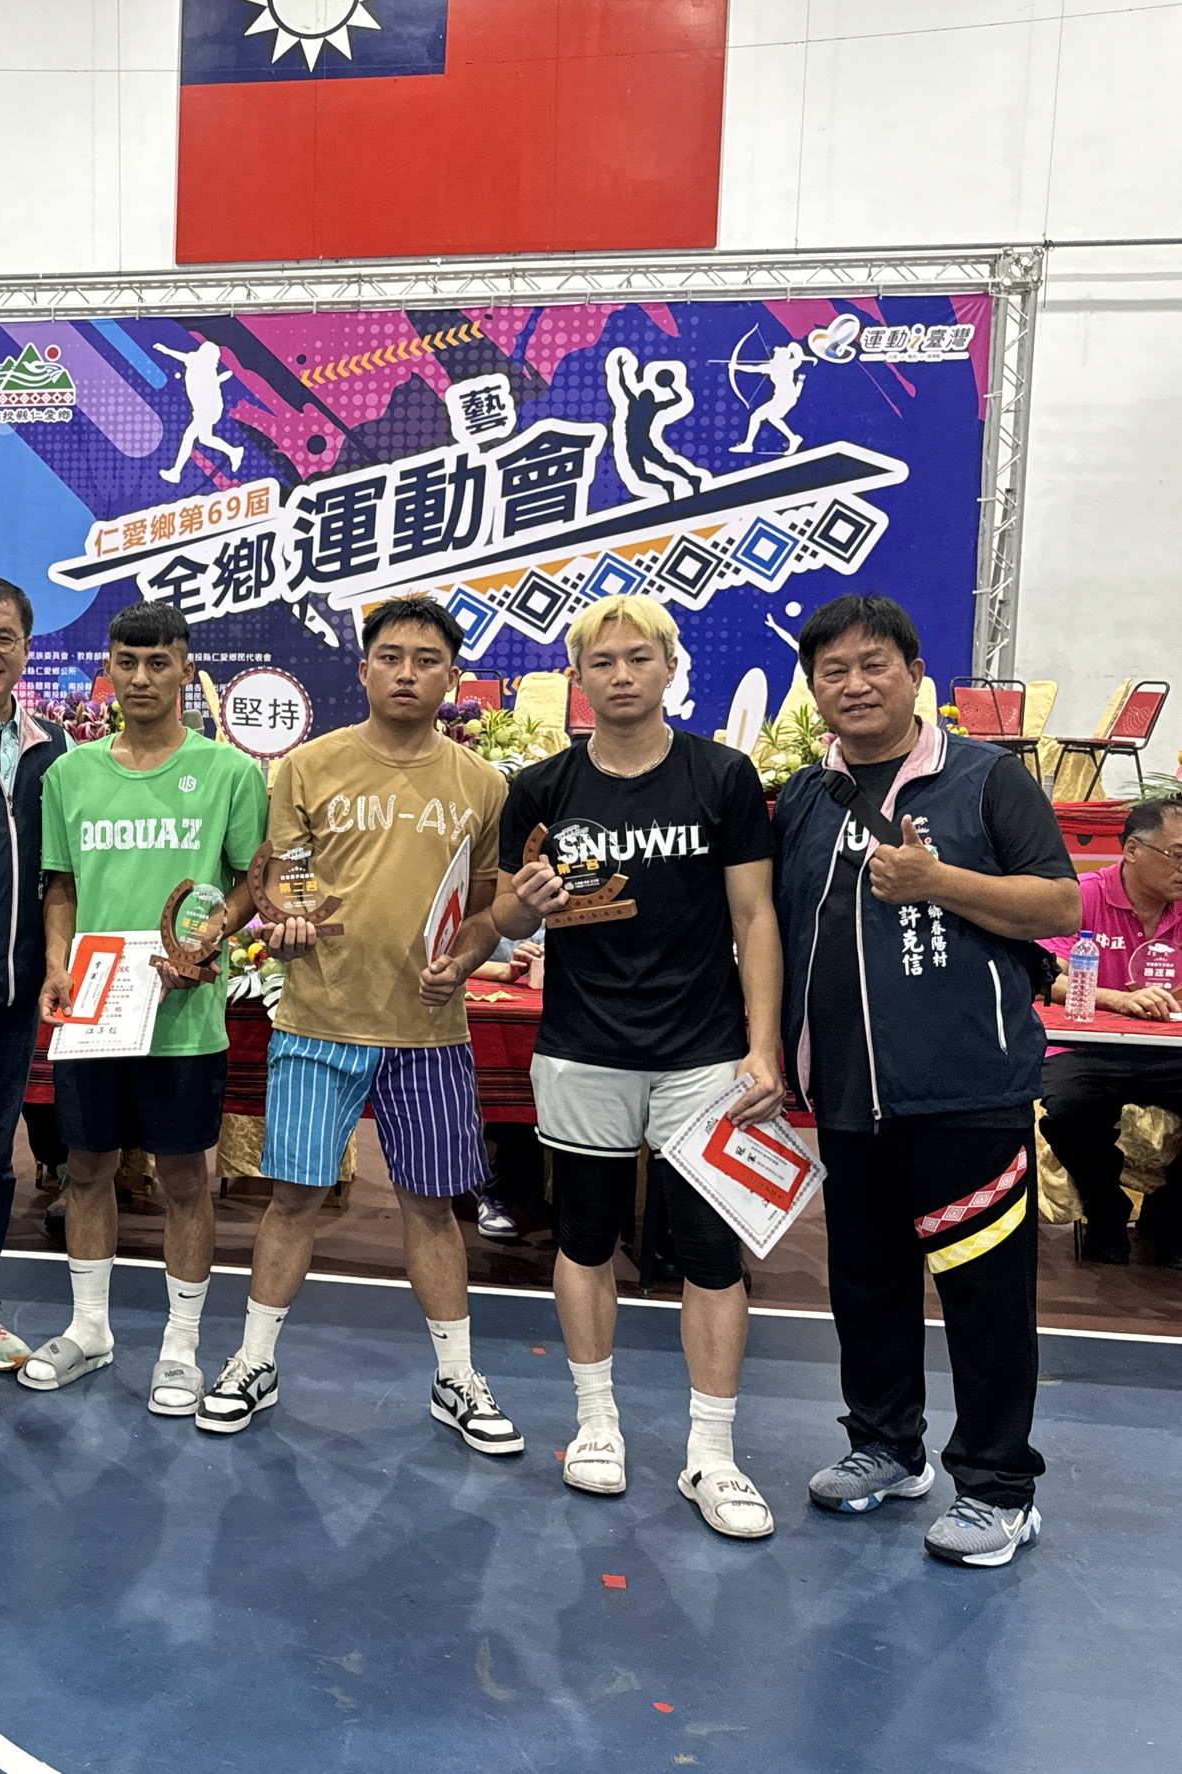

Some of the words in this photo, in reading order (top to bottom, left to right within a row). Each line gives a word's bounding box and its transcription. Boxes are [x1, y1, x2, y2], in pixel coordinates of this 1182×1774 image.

[459, 385, 509, 435] 藝
[94, 486, 271, 557] 仁愛鄉第69屆
[232, 696, 300, 730] 堅持
[327, 794, 474, 841] CIN-AY
[898, 905, 924, 976] 許克信
[1095, 932, 1126, 950] 中正
[576, 1441, 616, 1454] FILA
[716, 1479, 757, 1496] FILA
